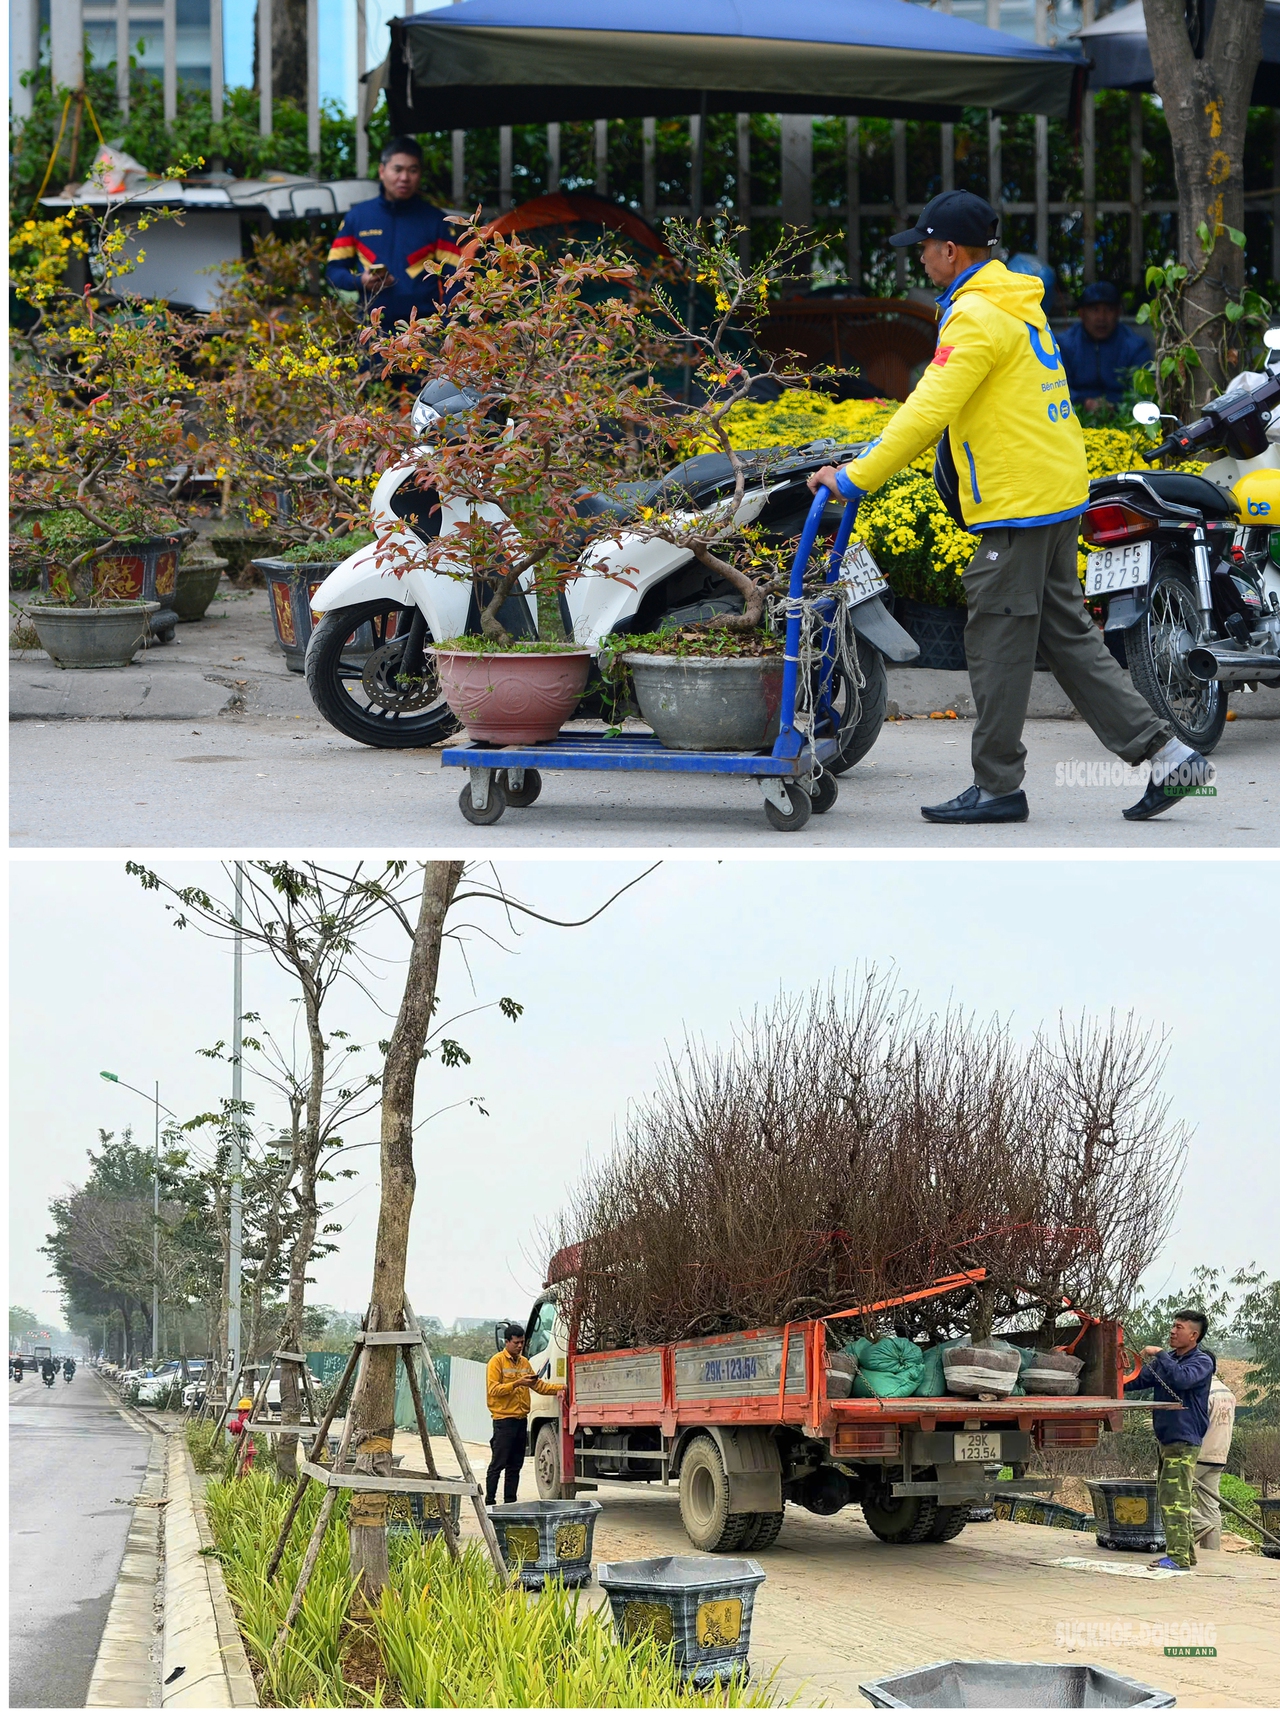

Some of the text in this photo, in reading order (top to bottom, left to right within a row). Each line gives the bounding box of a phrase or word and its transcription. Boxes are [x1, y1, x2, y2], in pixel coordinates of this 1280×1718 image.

[1247, 497, 1271, 516] be
[1094, 566, 1140, 591] 8279
[705, 1356, 757, 1382] 29K-123.54
[968, 1434, 988, 1446] 29K
[961, 1447, 996, 1459] 123.54
